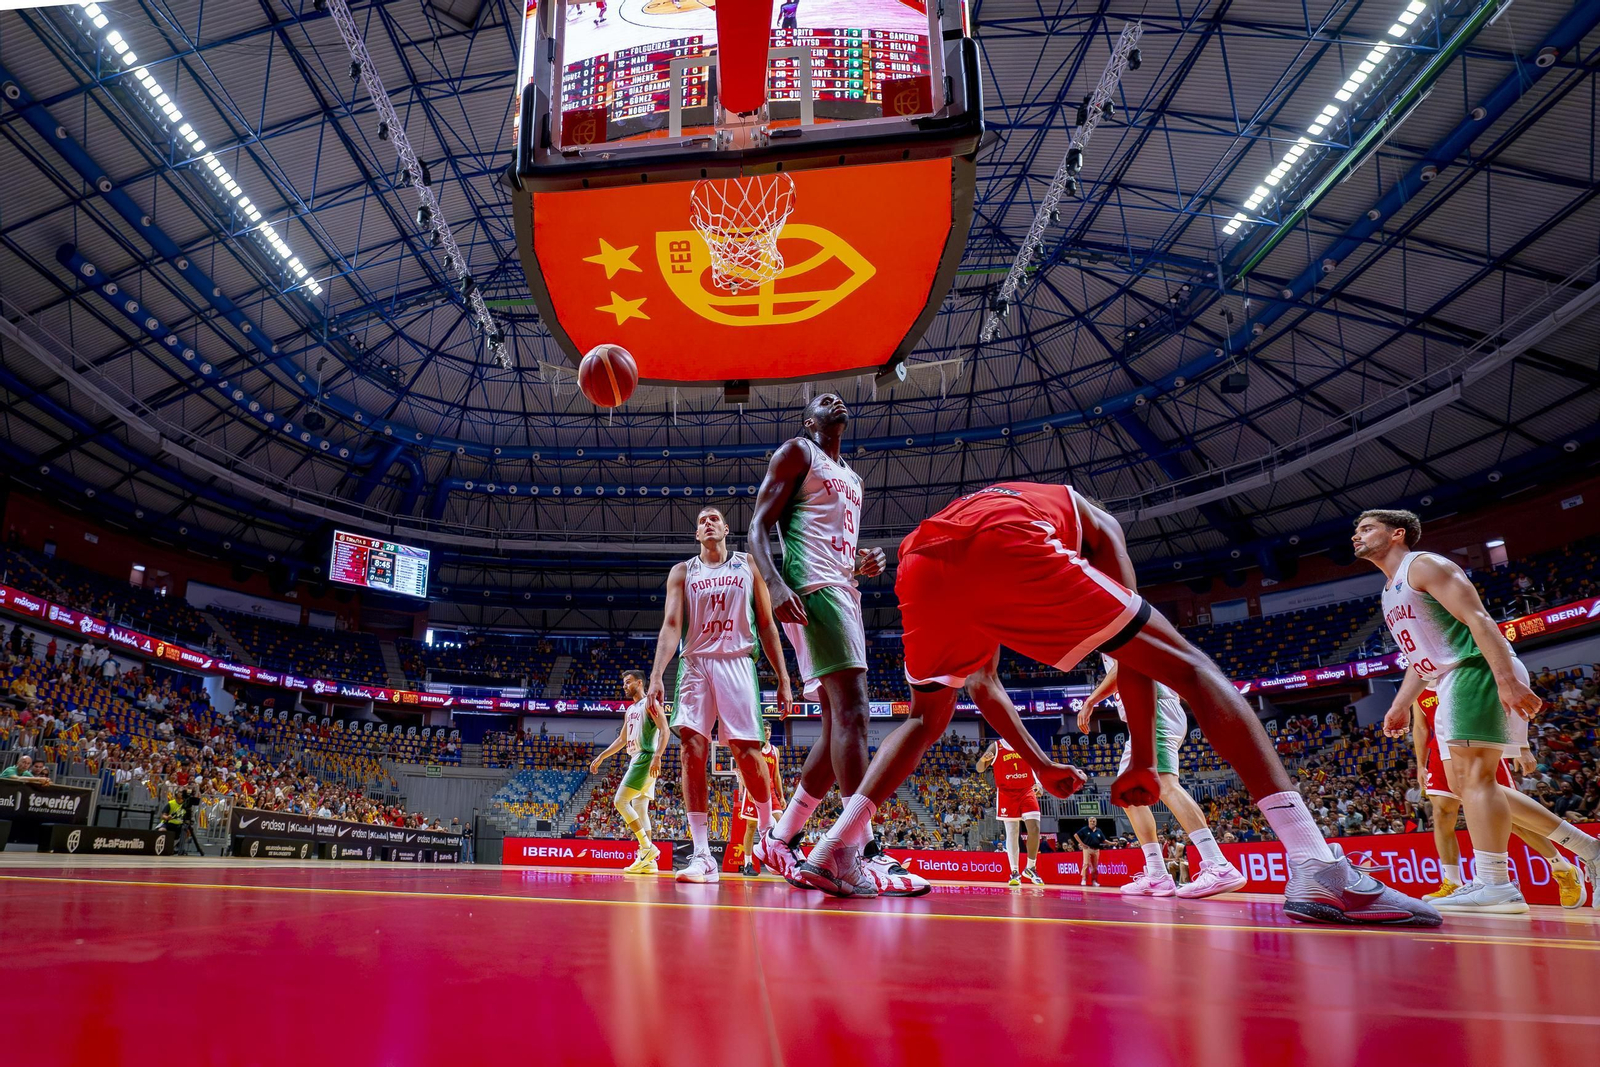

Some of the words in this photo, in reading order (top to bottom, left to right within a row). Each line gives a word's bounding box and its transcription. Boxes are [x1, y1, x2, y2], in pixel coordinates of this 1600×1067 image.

[889, 32, 919, 42] GAMEIRO
[631, 42, 670, 56] FOLGUEIRAS
[890, 53, 909, 61] SILVA
[669, 240, 692, 273] FEB
[691, 576, 744, 593] PORTUGAL
[710, 593, 725, 611] 14
[1546, 606, 1587, 623] IBERIA
[181, 652, 203, 664] IBERIA
[1262, 675, 1306, 687] azulmarino
[261, 820, 285, 831] endesa
[93, 837, 144, 849] #LaFamilia
[523, 846, 573, 858] IBERIA
[590, 849, 625, 859] Talento
[917, 859, 959, 871] Talento
[962, 863, 968, 871] a
[970, 861, 1002, 872] bordo
[1057, 863, 1080, 874] IBERIA
[1111, 862, 1127, 874] bordo
